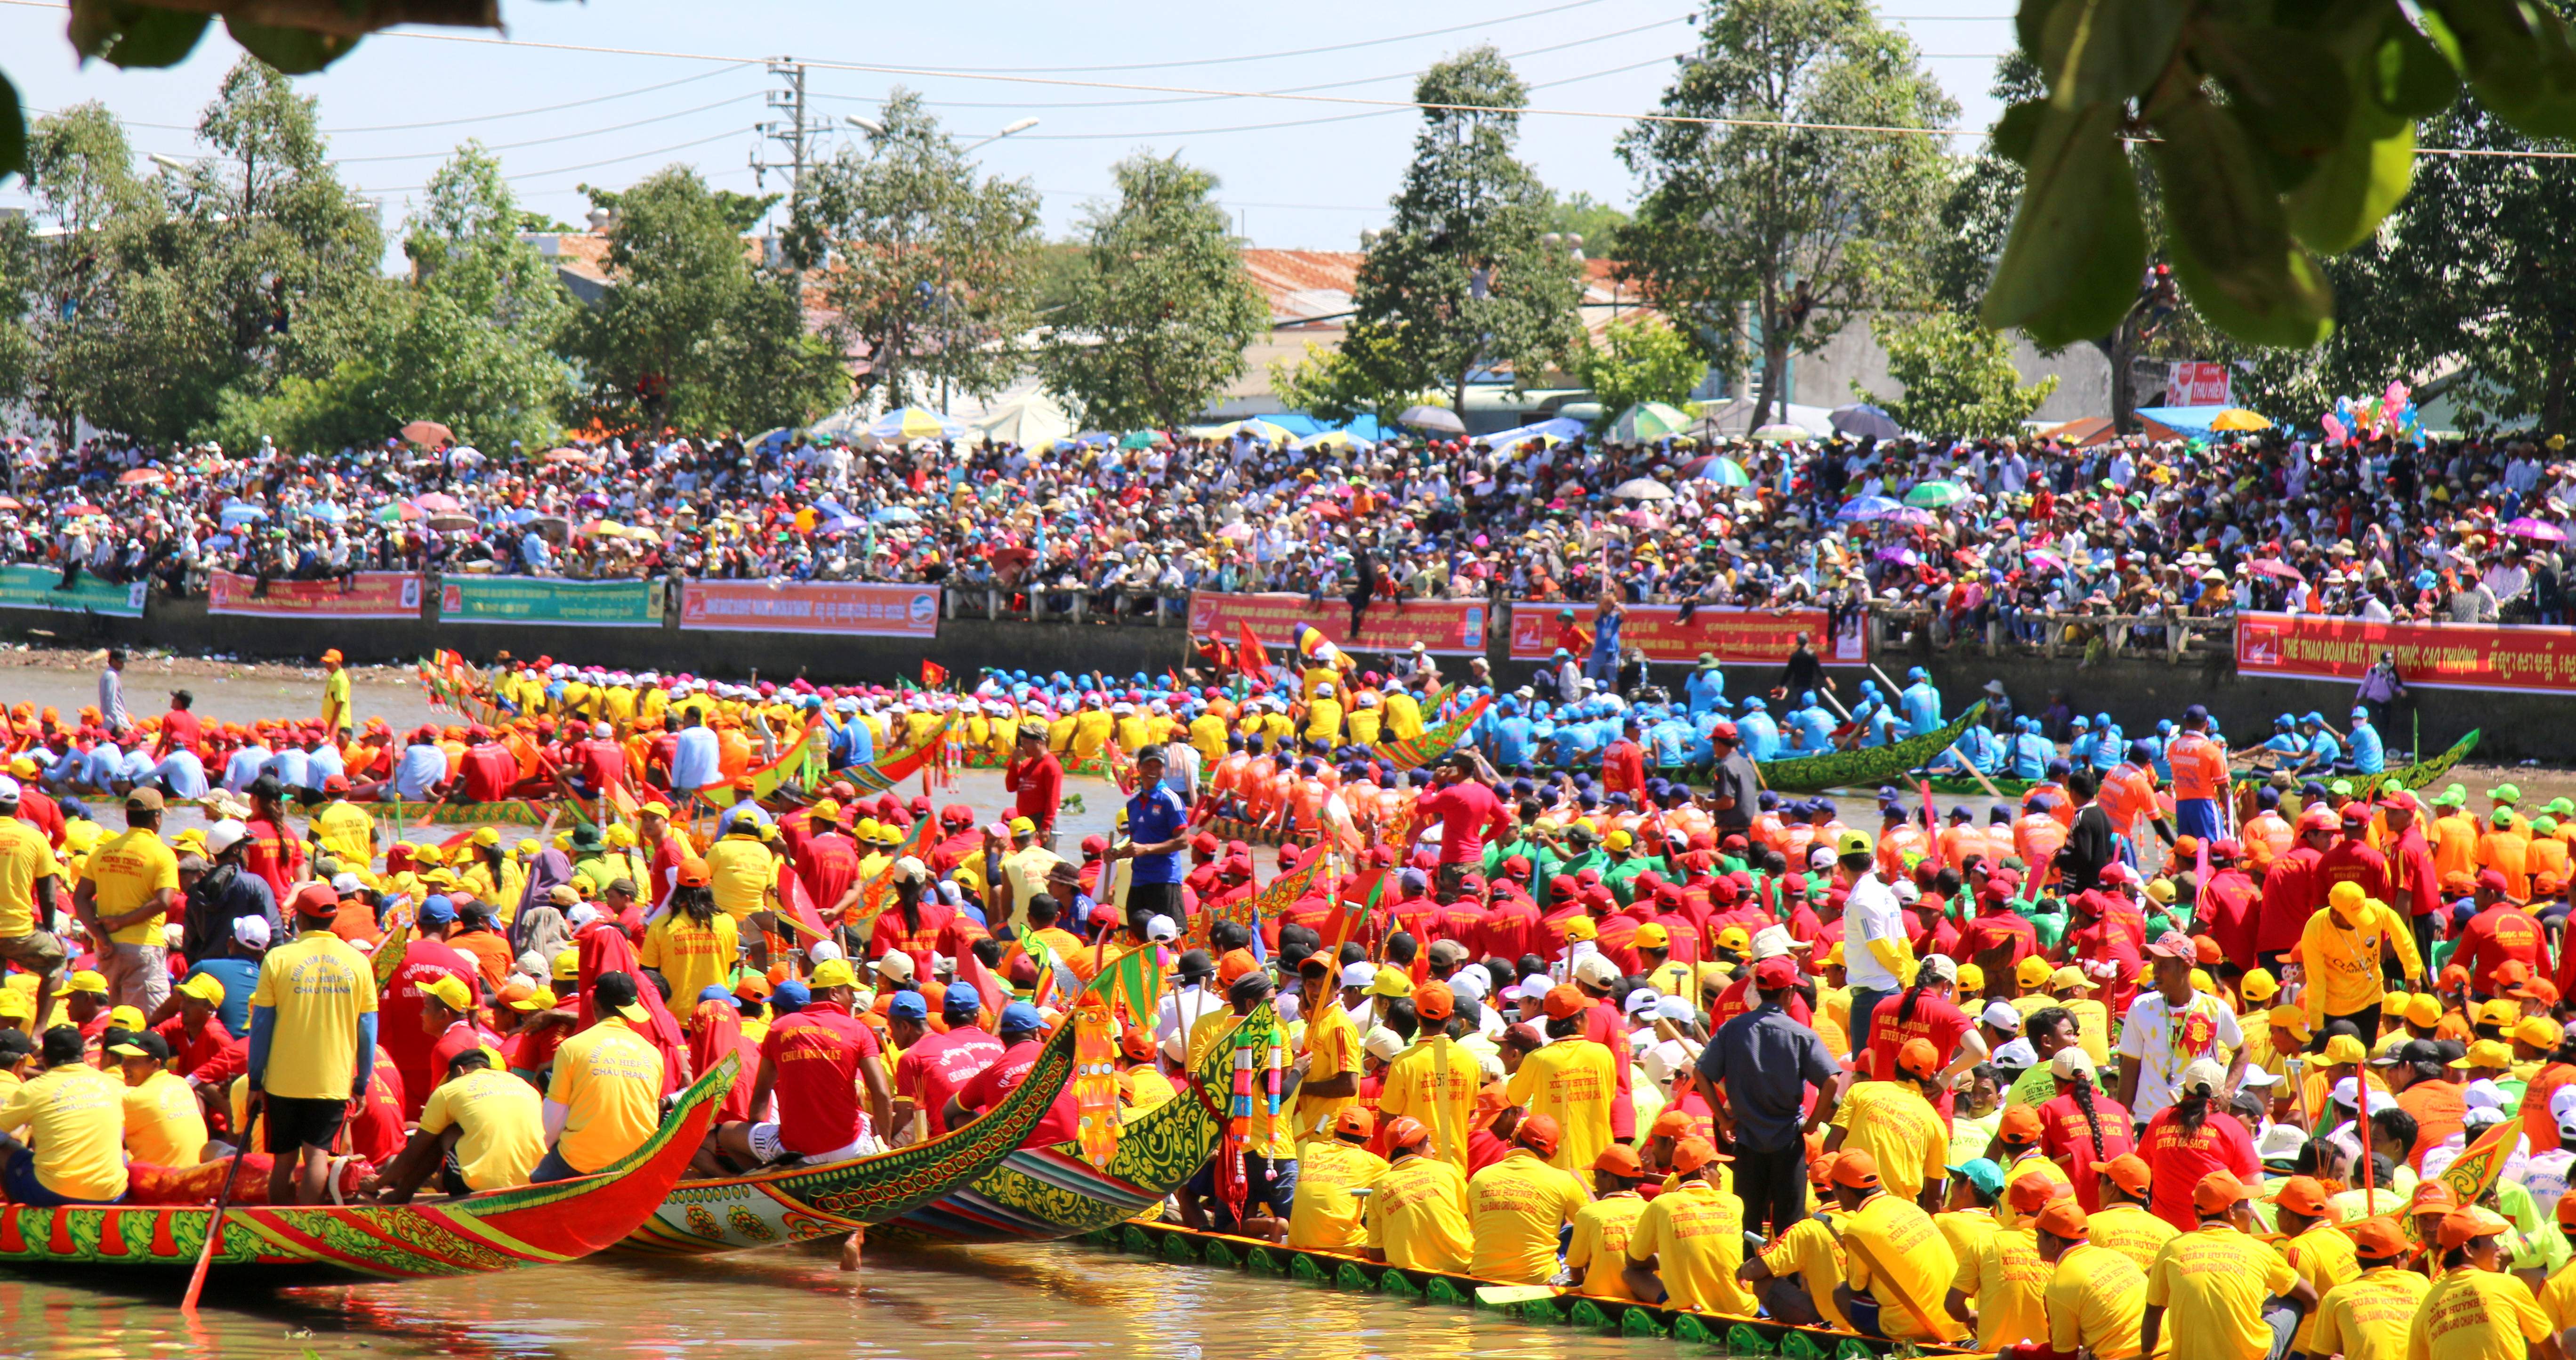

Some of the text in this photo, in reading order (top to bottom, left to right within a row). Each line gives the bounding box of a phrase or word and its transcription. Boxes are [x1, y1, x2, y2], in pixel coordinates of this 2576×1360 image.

[2193, 377, 2225, 399] THU HIỀN
[2283, 629, 2300, 659] THỂ
[2300, 639, 2322, 661] THAO
[2323, 636, 2345, 662] ĐOÀN
[2347, 633, 2365, 668] KẾT,
[2398, 642, 2420, 672] THỰC,
[2422, 647, 2440, 668] CAO
[2443, 644, 2477, 675] THƯỢNG
[2333, 949, 2377, 971] QATAR
[291, 964, 306, 982] CHÙA
[304, 955, 319, 966] KOM
[322, 955, 339, 965] PONG
[294, 985, 350, 994] CHÂU THÀNH
[798, 1026, 820, 1034] GHE
[589, 1045, 602, 1064] CHÙA
[782, 1046, 802, 1062] CHÙA
[620, 1058, 642, 1067] HIỆP
[592, 1068, 649, 1080] CHÂU THÀNH
[2105, 1123, 2122, 1136] SÁCH
[2156, 1135, 2176, 1150] HUYỆN
[2107, 1237, 2130, 1247] XUÂN
[2002, 1255, 2028, 1265] XUÂN
[2180, 1251, 2205, 1263] XUÂN
[2207, 1251, 2241, 1261] HUỲNH
[2350, 1296, 2378, 1308] XUÂN
[2414, 1297, 2419, 1305] 2
[2449, 1297, 2480, 1314] HUỲNH
[2482, 1297, 2487, 1306] 3
